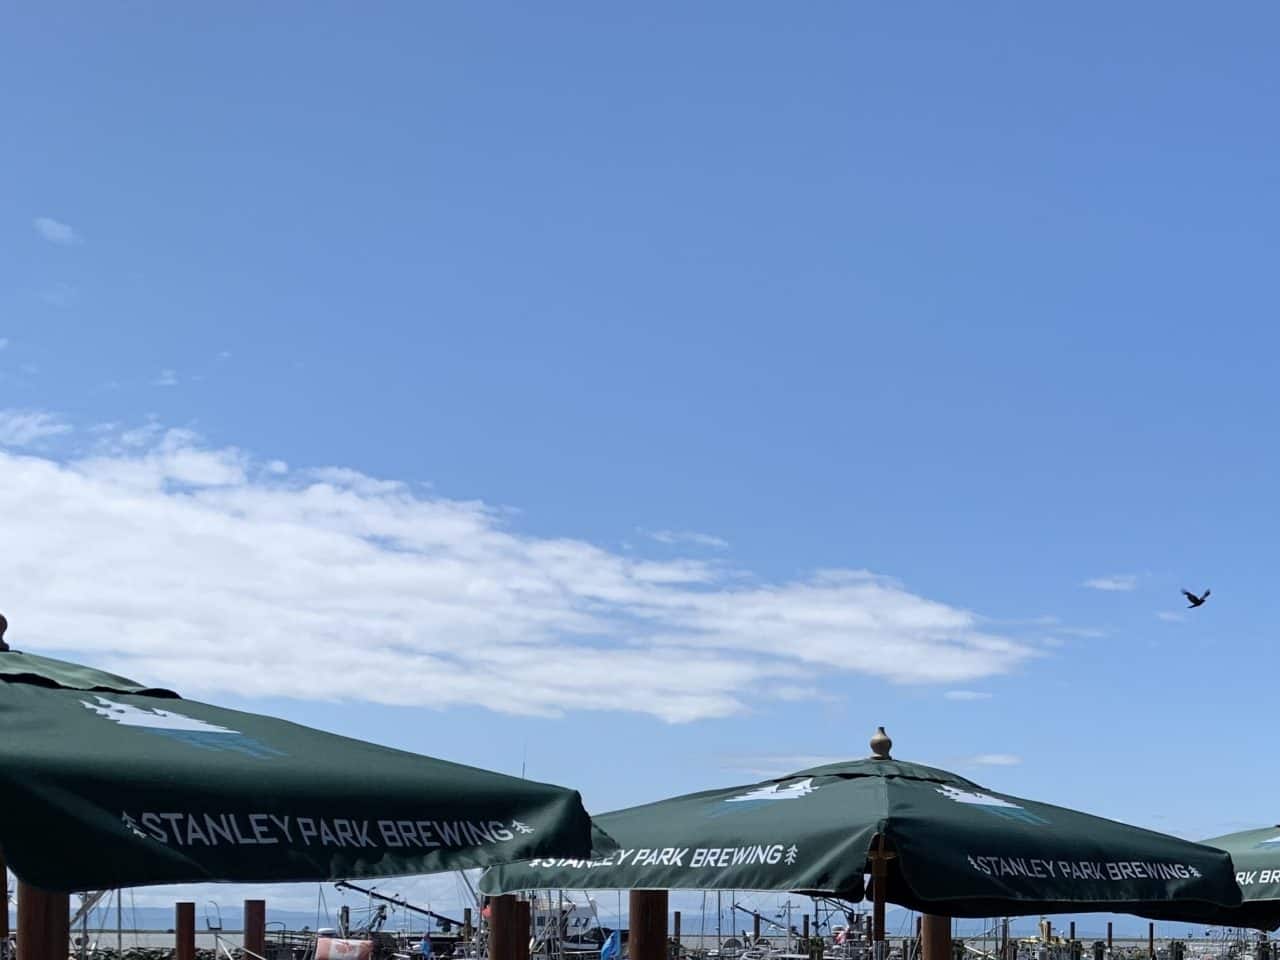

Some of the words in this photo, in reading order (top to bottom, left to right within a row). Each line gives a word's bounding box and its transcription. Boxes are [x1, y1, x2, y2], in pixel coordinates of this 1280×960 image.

[140, 812, 294, 846] STANLEY
[300, 817, 373, 848] PARK
[381, 819, 515, 848] BREWING
[632, 847, 690, 867] PARK
[690, 844, 783, 868] BREWING
[976, 856, 1058, 879] STANLEY
[1056, 860, 1107, 881] PARK
[1105, 862, 1190, 881] BREWING
[1235, 870, 1257, 886] RK
